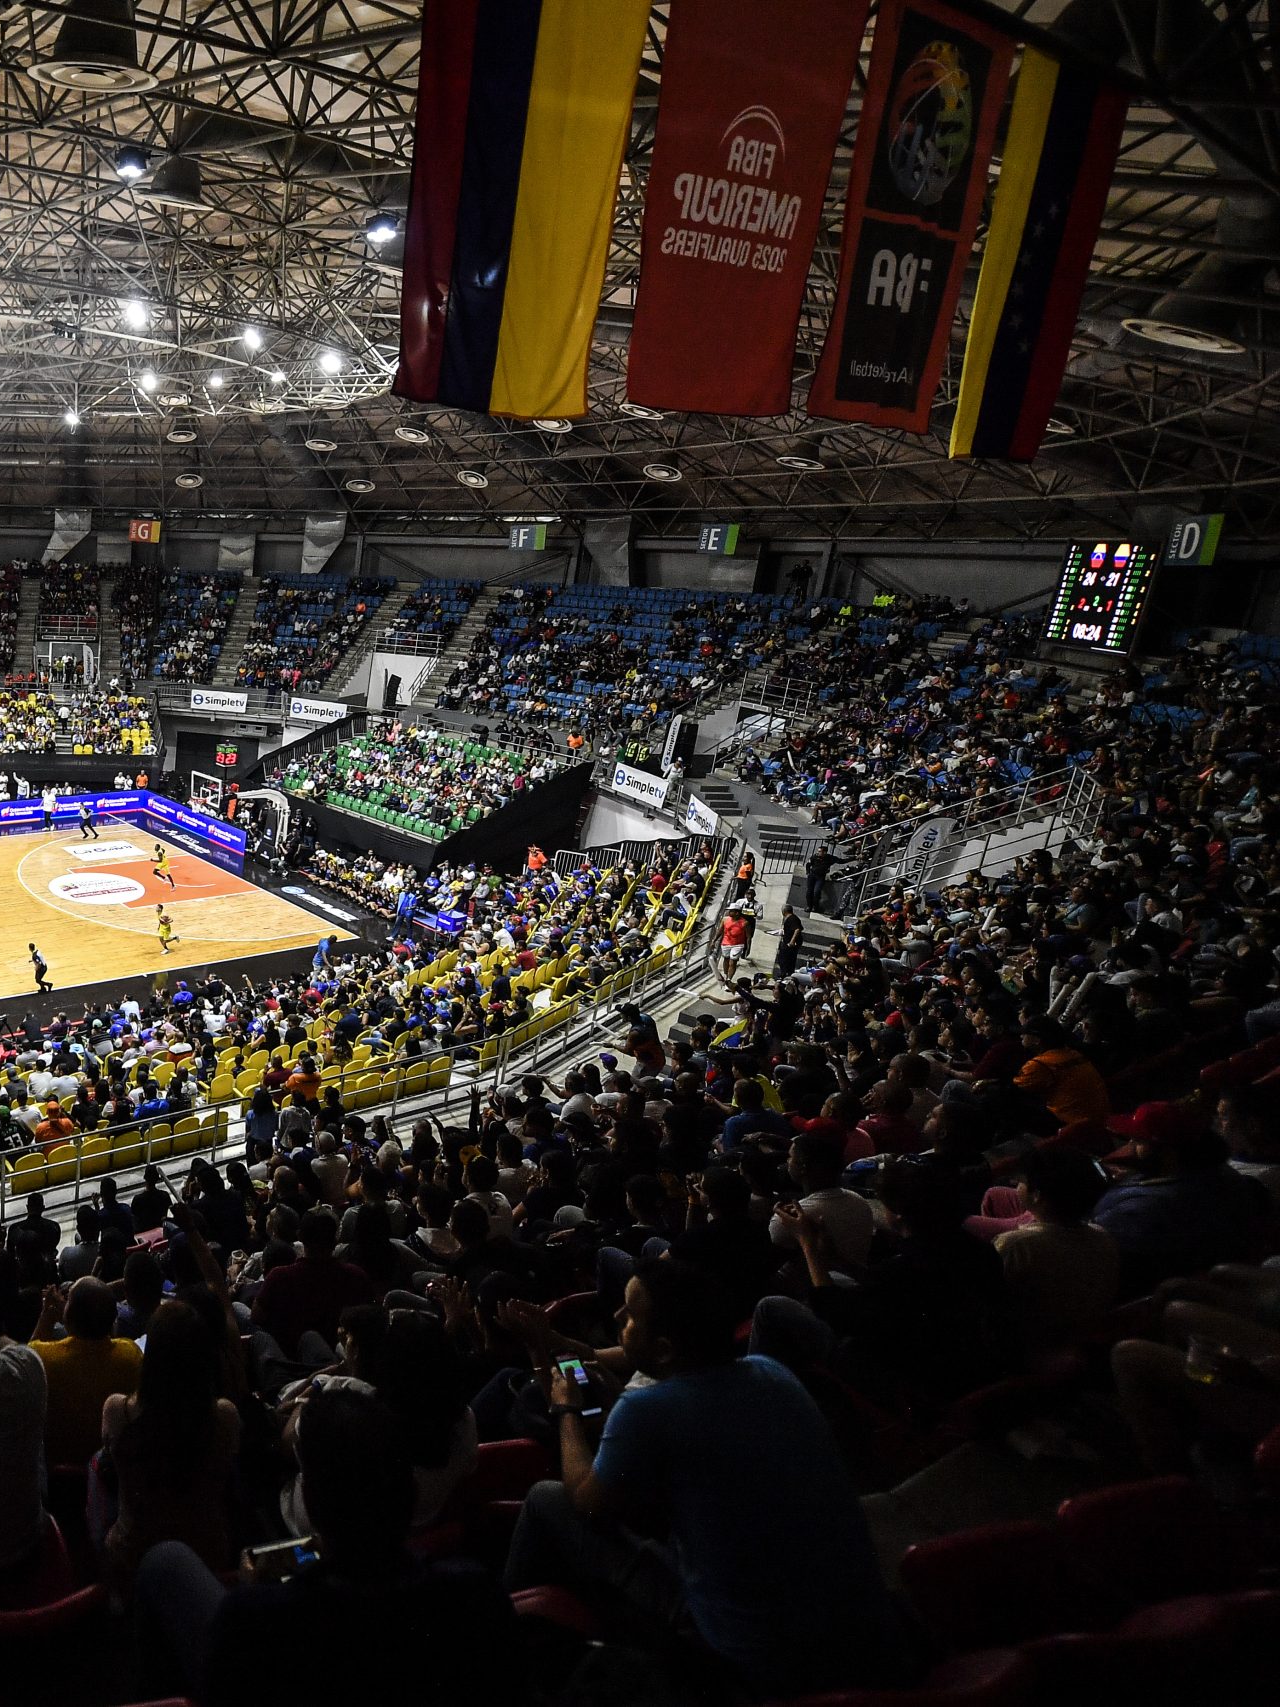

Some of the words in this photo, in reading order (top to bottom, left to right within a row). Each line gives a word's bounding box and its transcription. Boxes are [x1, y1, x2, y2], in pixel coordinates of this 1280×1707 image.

[137, 523, 149, 540] G
[518, 528, 530, 548] F
[699, 528, 710, 550] SECTOR
[707, 528, 721, 551] E
[1168, 523, 1183, 559] SECTOR
[1178, 522, 1201, 559] D
[1082, 571, 1098, 586] 24
[1105, 572, 1121, 587] 21
[1077, 597, 1087, 609] 2
[1092, 595, 1100, 607] 2
[204, 696, 245, 708] Simpletv
[303, 705, 344, 719] Simpletv
[625, 775, 666, 800] Simpletv
